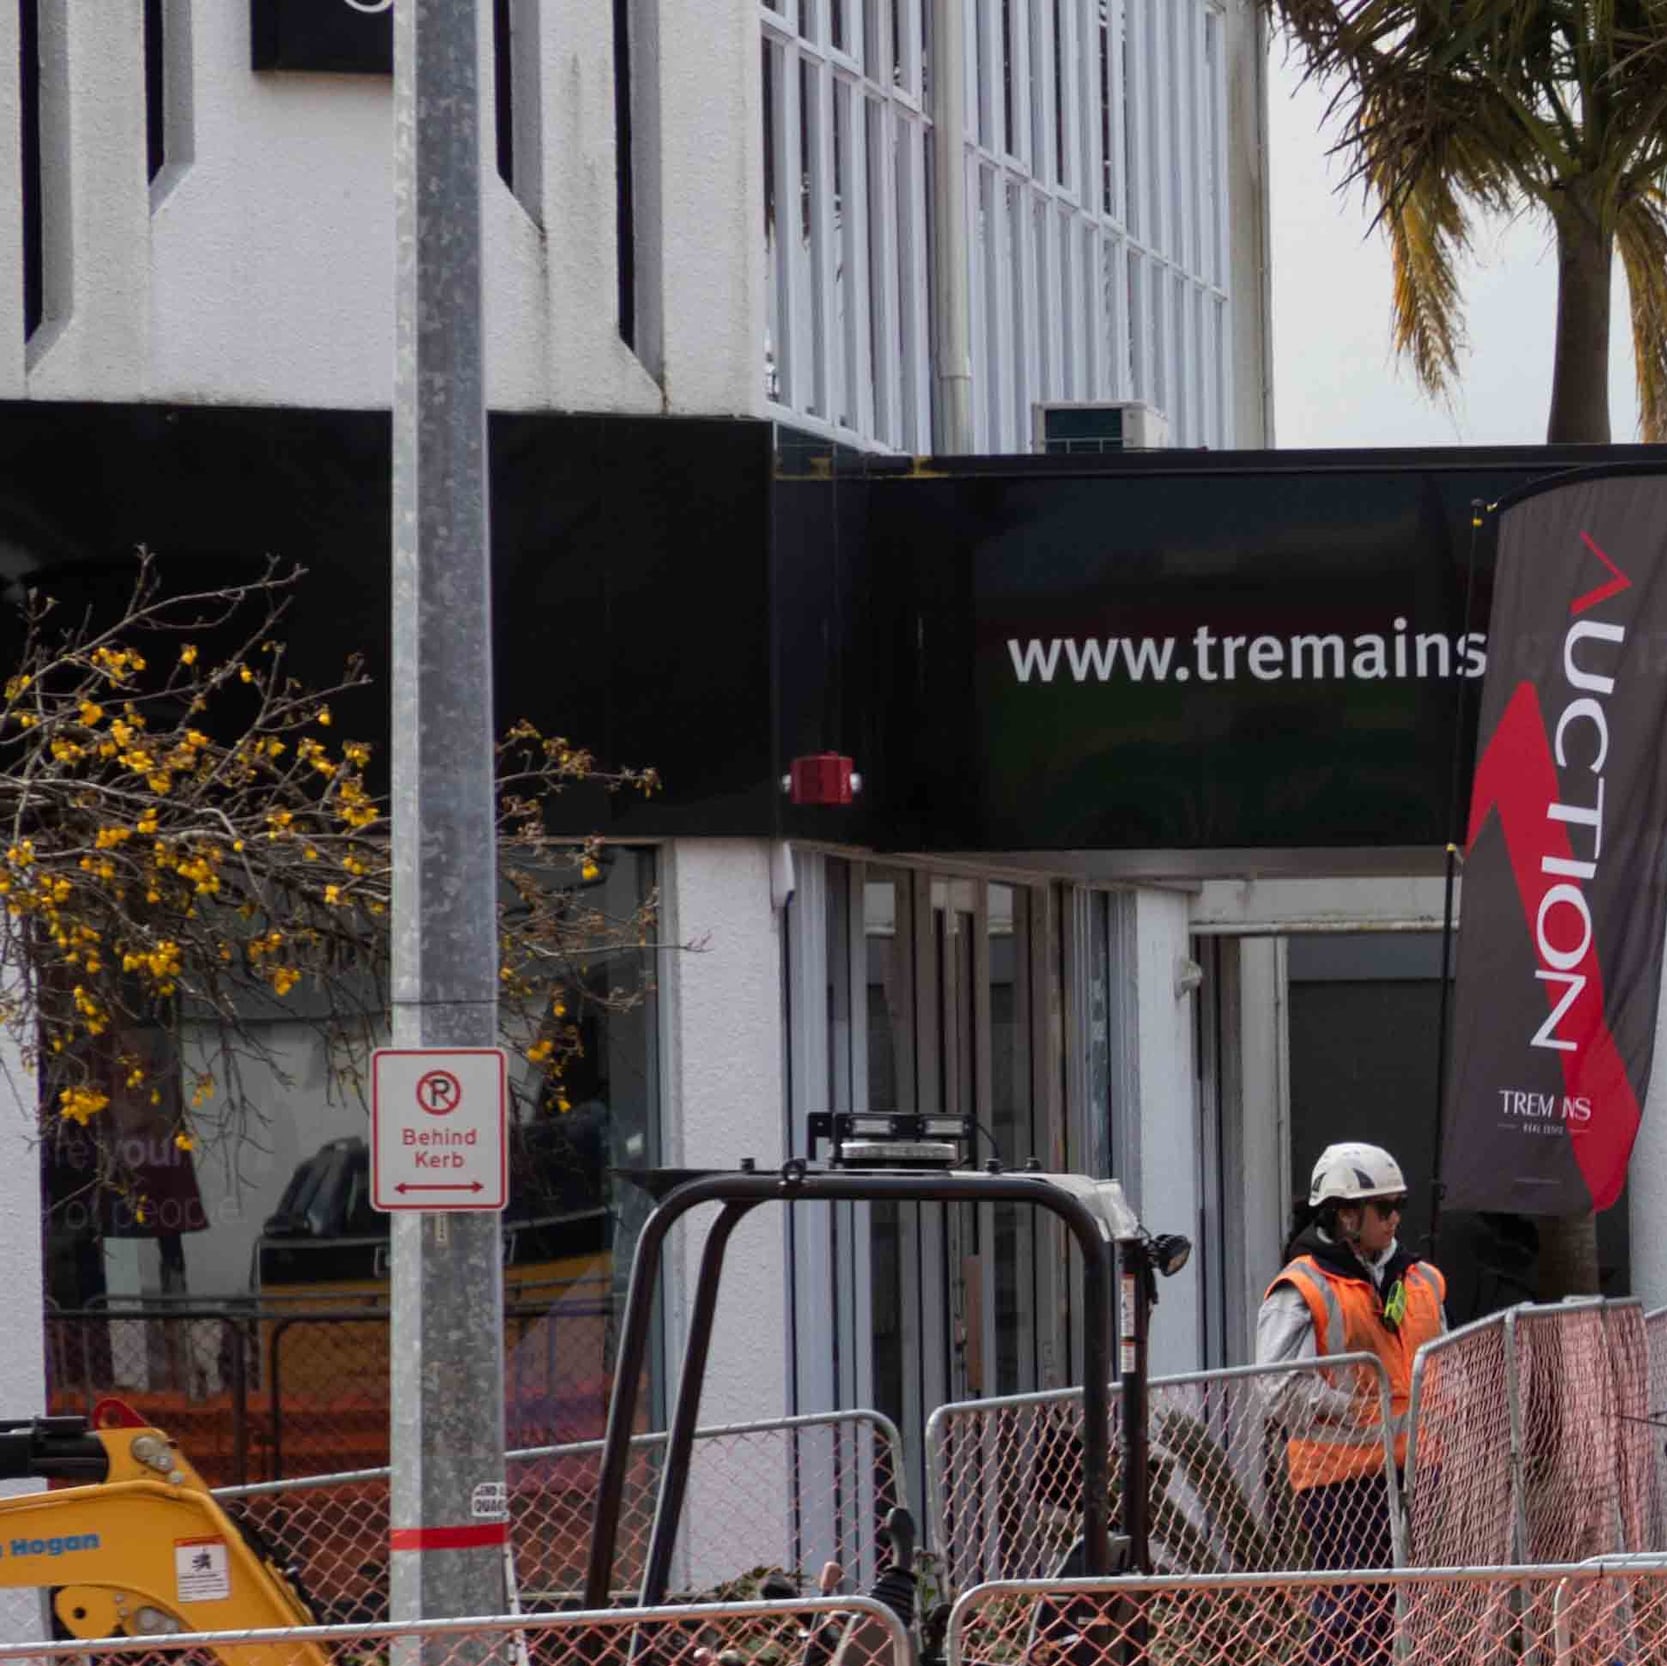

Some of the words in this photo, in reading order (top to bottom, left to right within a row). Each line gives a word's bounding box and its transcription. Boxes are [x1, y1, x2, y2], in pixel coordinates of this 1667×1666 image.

[1008, 617, 1486, 682] www.tremains
[402, 1129, 477, 1146] Behind
[414, 1151, 465, 1168] Kerb
[10, 1532, 100, 1557] Hogan
